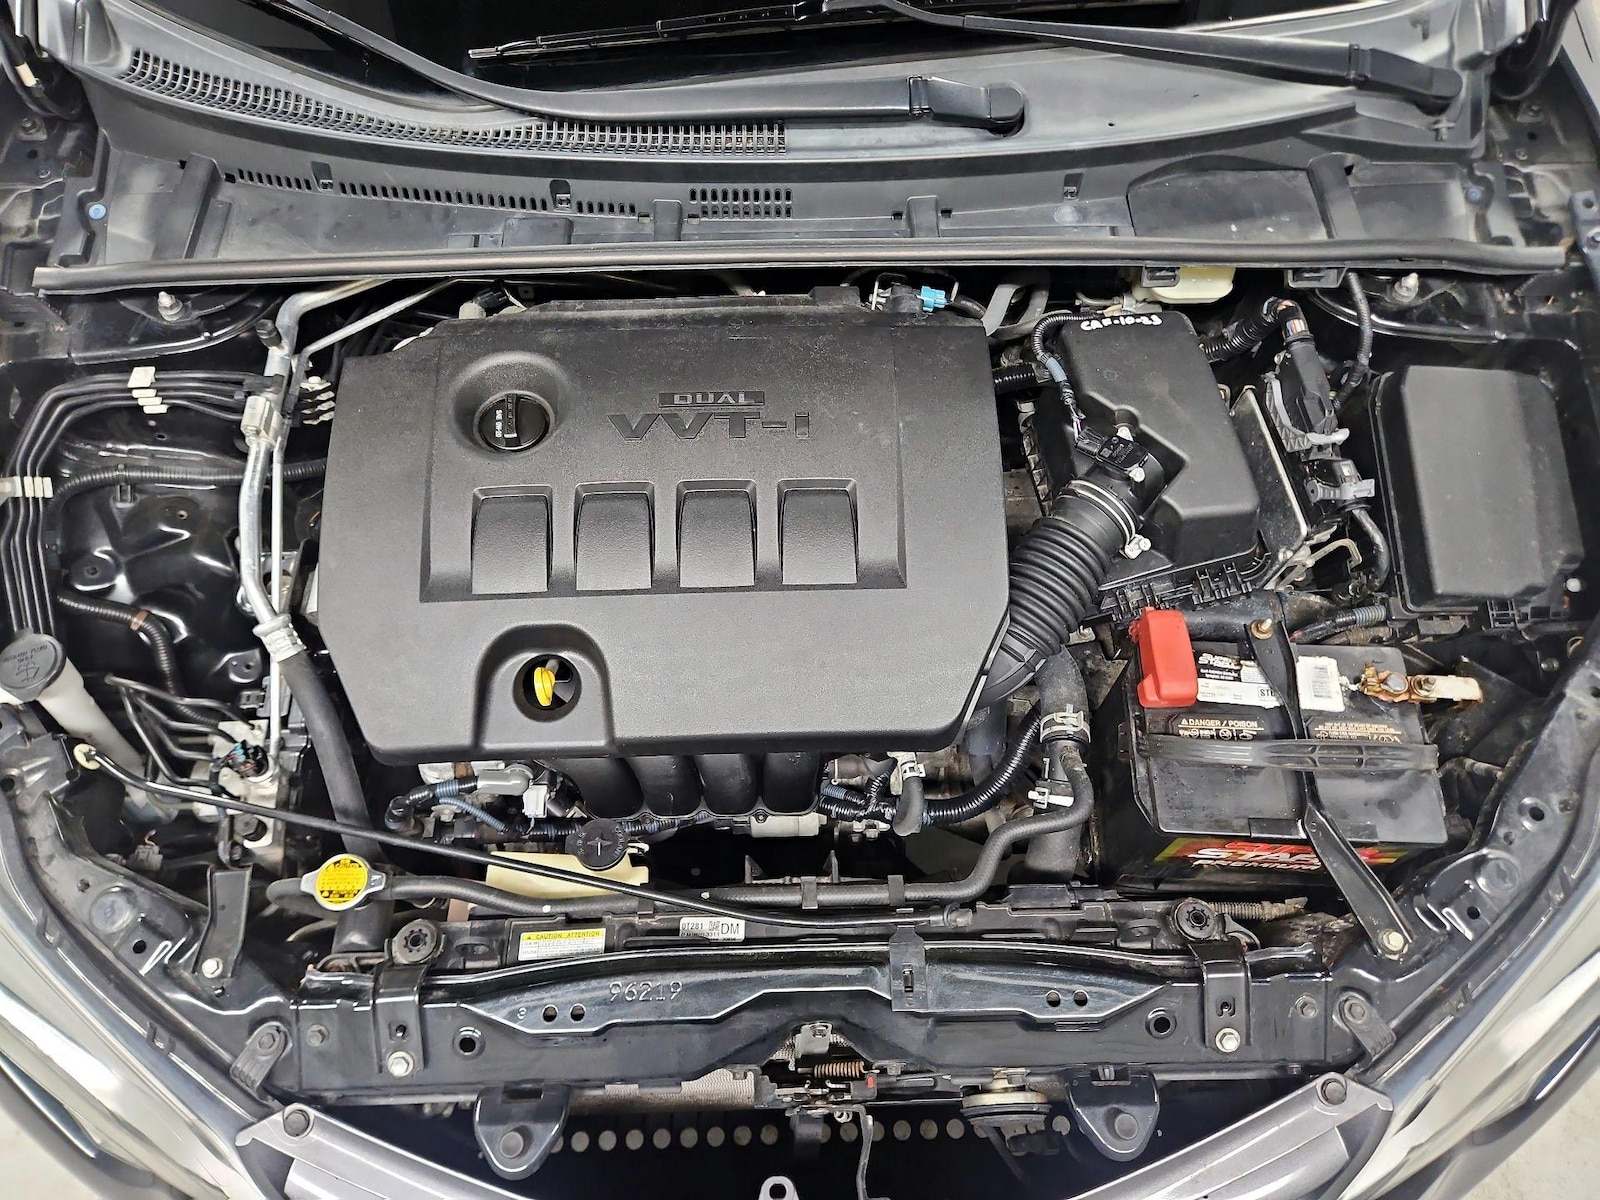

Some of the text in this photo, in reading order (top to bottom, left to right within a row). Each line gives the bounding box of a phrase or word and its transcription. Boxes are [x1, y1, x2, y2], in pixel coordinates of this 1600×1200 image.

[673, 391, 755, 405] DUAL
[1188, 718, 1221, 727] DANGER
[1228, 720, 1258, 728] POISON
[720, 922, 740, 935] DM
[609, 981, 683, 1002] 96219
